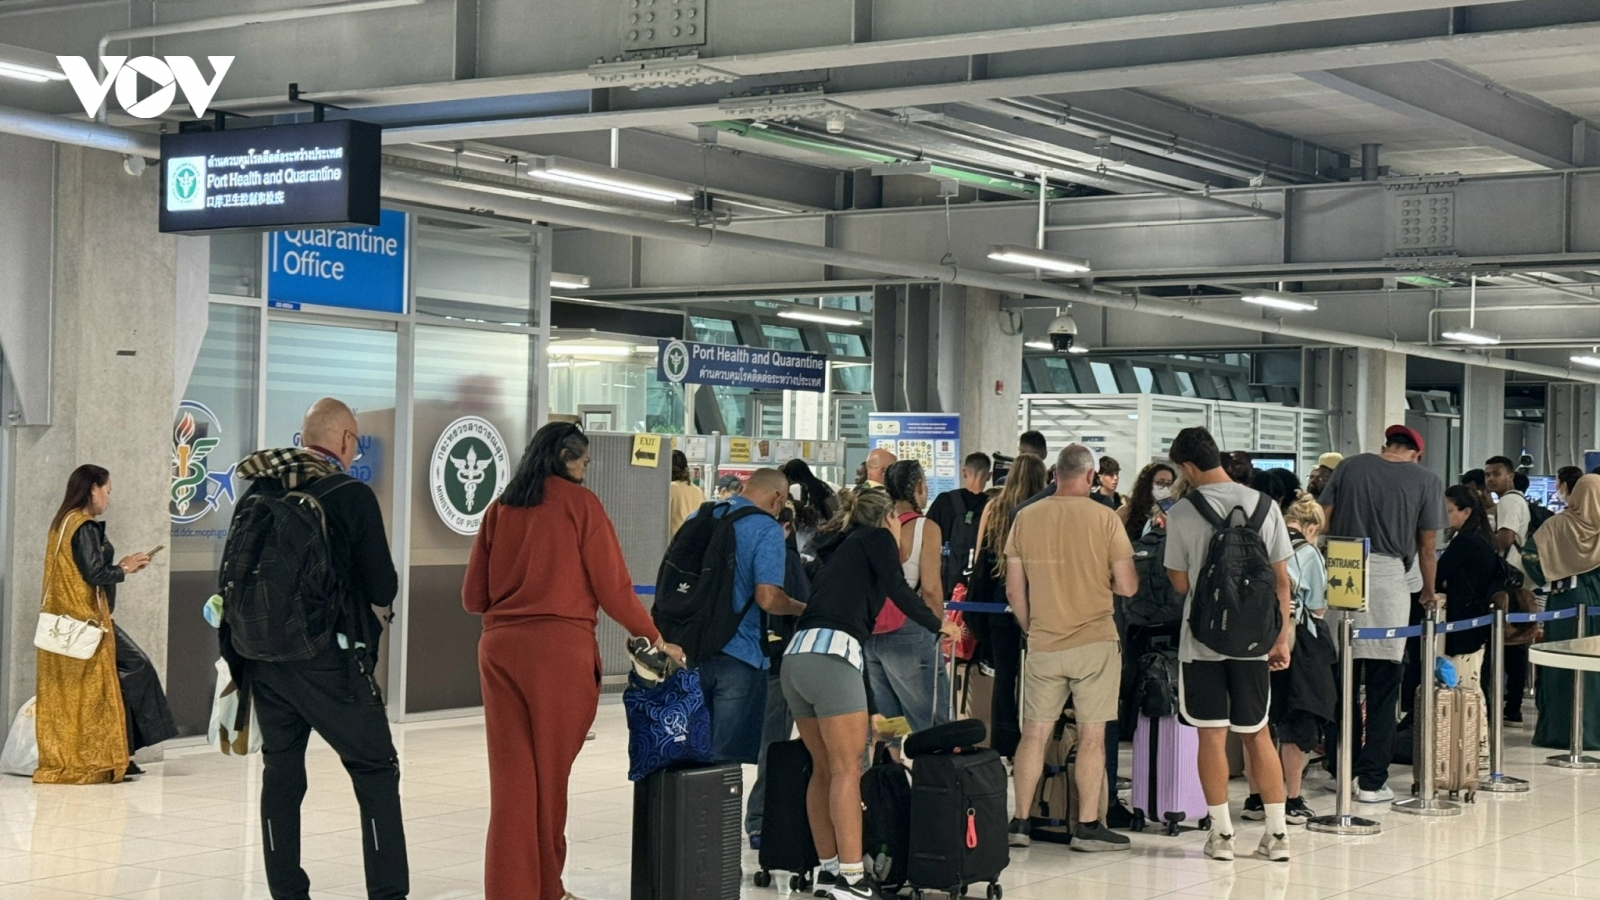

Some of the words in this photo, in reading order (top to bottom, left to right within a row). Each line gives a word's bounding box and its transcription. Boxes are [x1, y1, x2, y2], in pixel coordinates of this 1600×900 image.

[207, 173, 229, 189] Port
[229, 170, 262, 187] Health
[263, 168, 284, 185] and
[284, 166, 342, 184] Quarantine
[284, 227, 398, 256] Quarantine
[283, 250, 345, 280] Office
[692, 344, 714, 360] Port
[716, 347, 750, 364] Health
[751, 350, 770, 365] and
[772, 351, 824, 370] Quarantine
[699, 364, 822, 387] ด่านควบคุมโรคติดต่อระหว่างประเทศ
[639, 436, 656, 447] EXIT
[436, 485, 456, 521] MINISTRY
[456, 517, 465, 527] OF
[1327, 557, 1361, 569] ENTRANCE
